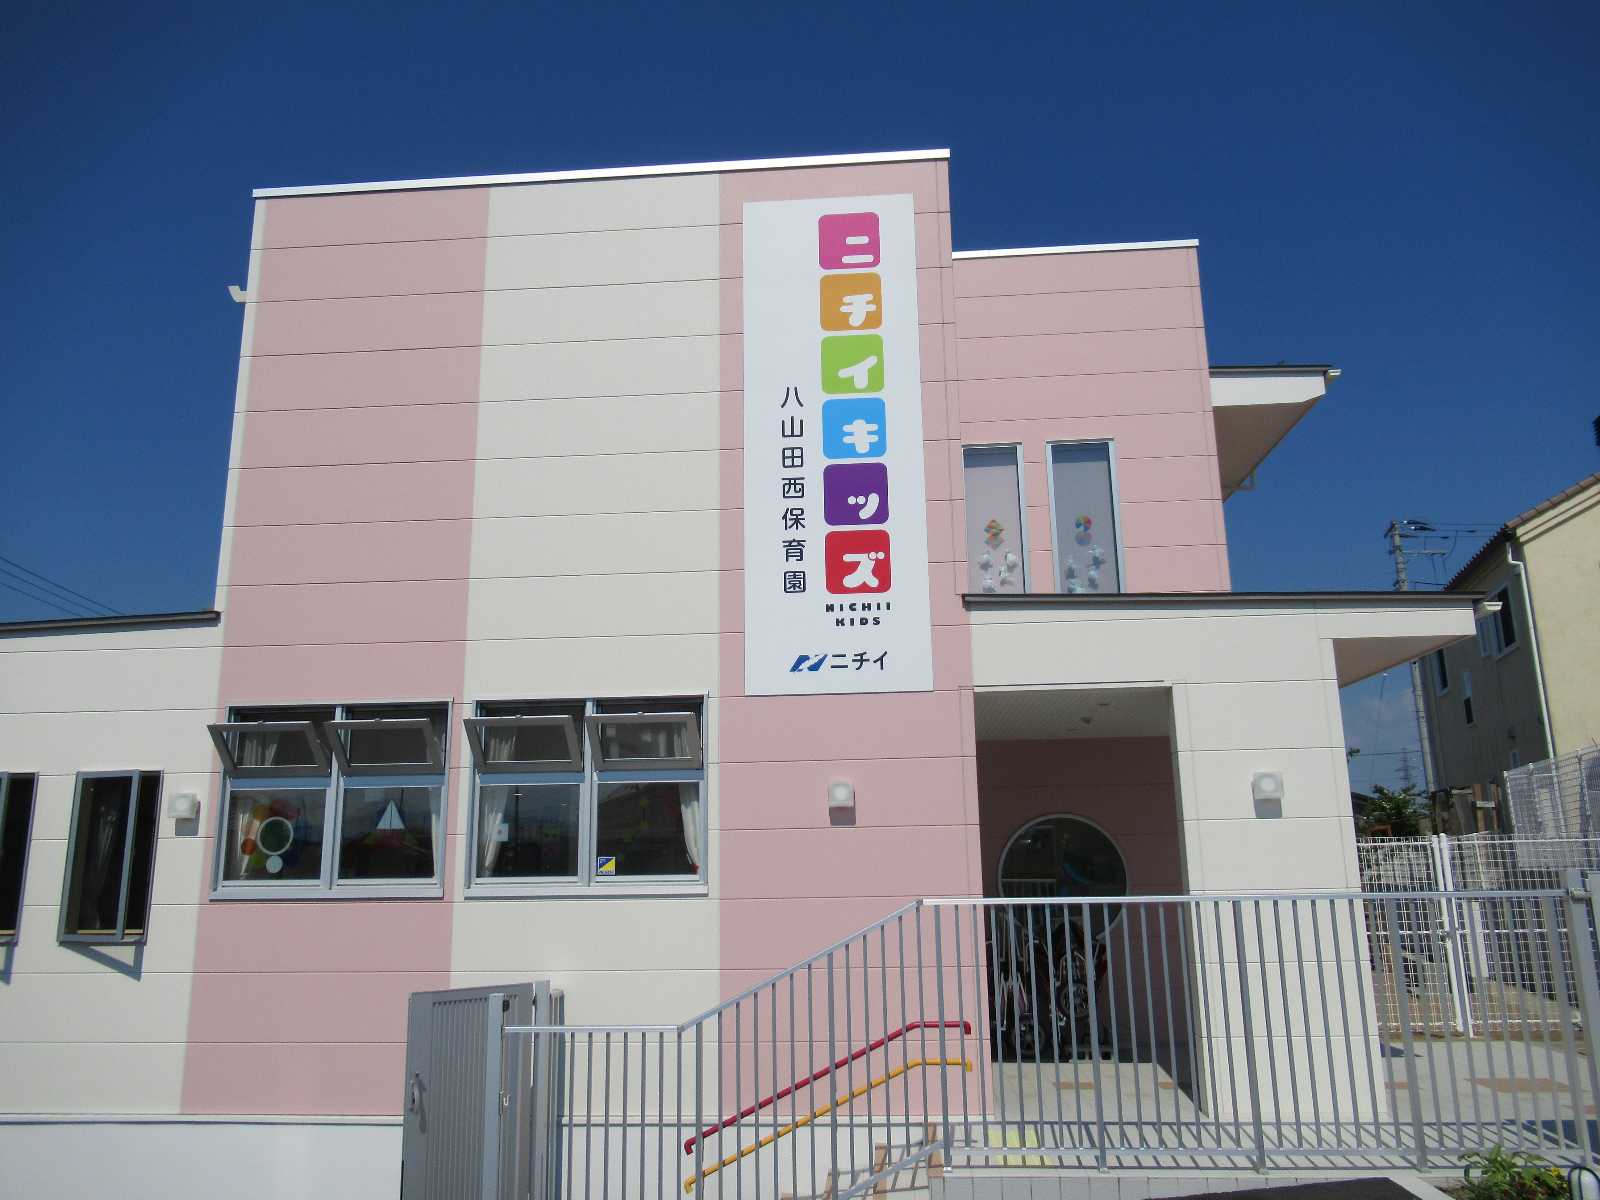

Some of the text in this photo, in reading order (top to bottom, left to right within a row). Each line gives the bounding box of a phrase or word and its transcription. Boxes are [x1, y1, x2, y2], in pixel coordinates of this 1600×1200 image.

[836, 233, 886, 589] ニチイキッズ
[781, 386, 806, 593] 八山田西保育園
[825, 602, 891, 612] NICHII
[835, 616, 881, 626] KIDS
[831, 650, 888, 671] ニチイ
